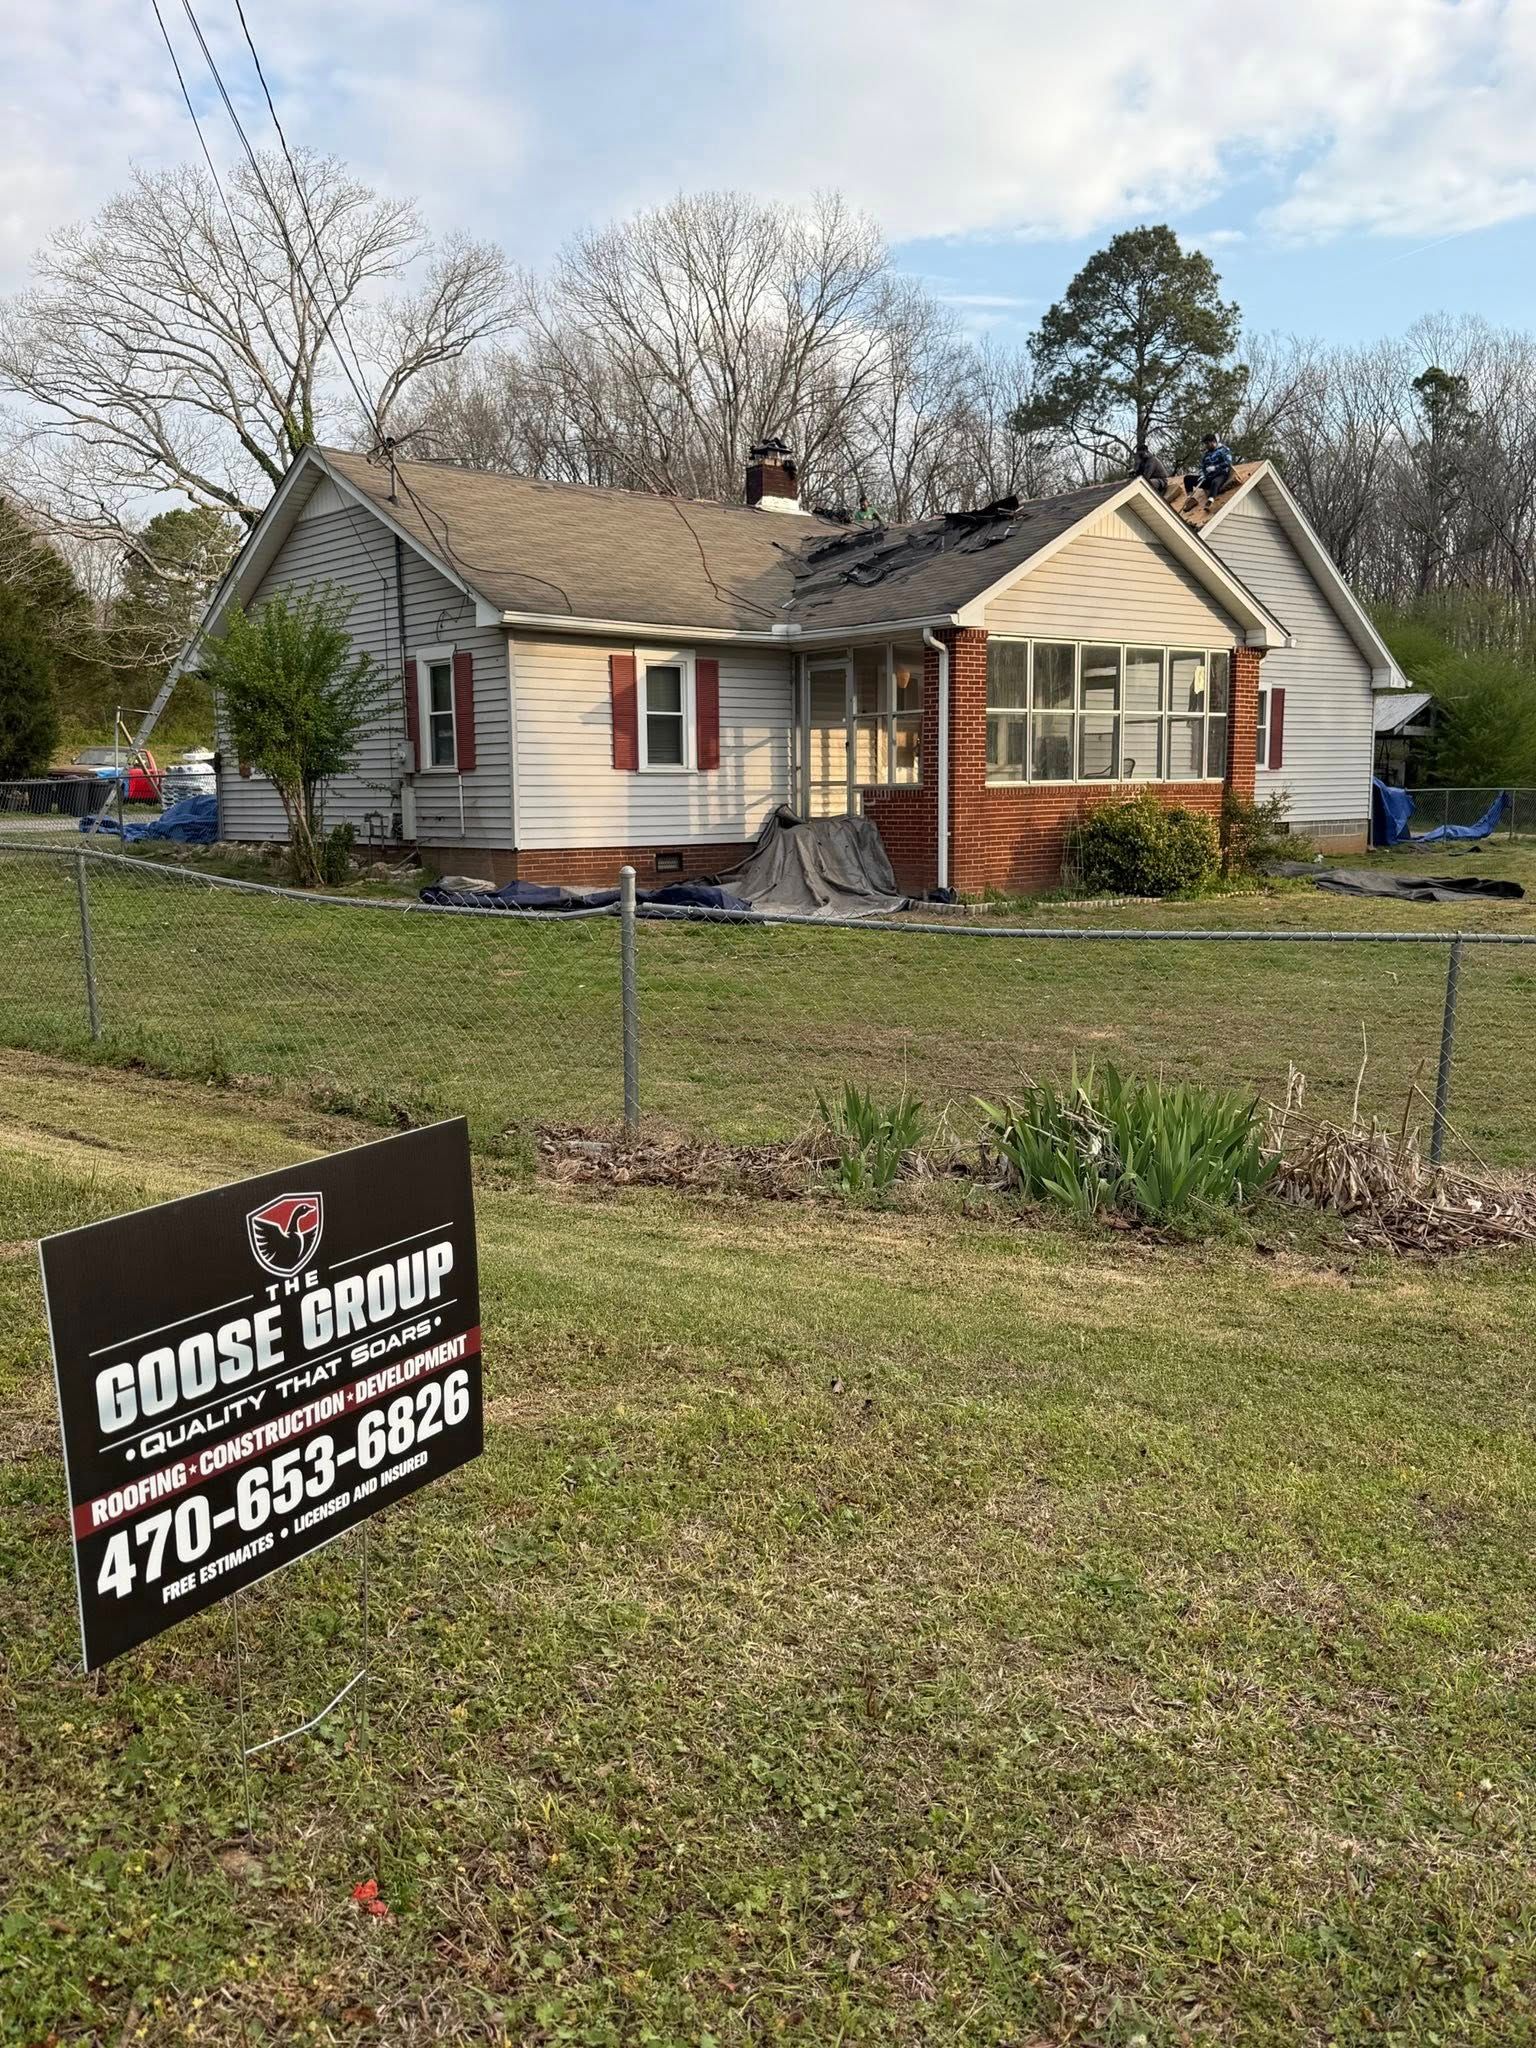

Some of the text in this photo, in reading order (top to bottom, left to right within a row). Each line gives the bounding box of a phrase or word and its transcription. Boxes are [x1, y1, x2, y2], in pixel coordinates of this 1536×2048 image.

[95, 1241, 454, 1434] GOOSE GROUP
[265, 1269, 319, 1301] THE
[91, 1334, 467, 1526] ROOFING CONSTRUCTION DEVELOPMENT
[140, 1319, 431, 1459] QUALITY THAT SOARS
[97, 1369, 470, 1599] 470-653-6826
[162, 1451, 428, 1604] FREE ESTIMATES LICENSED AND INSURED
